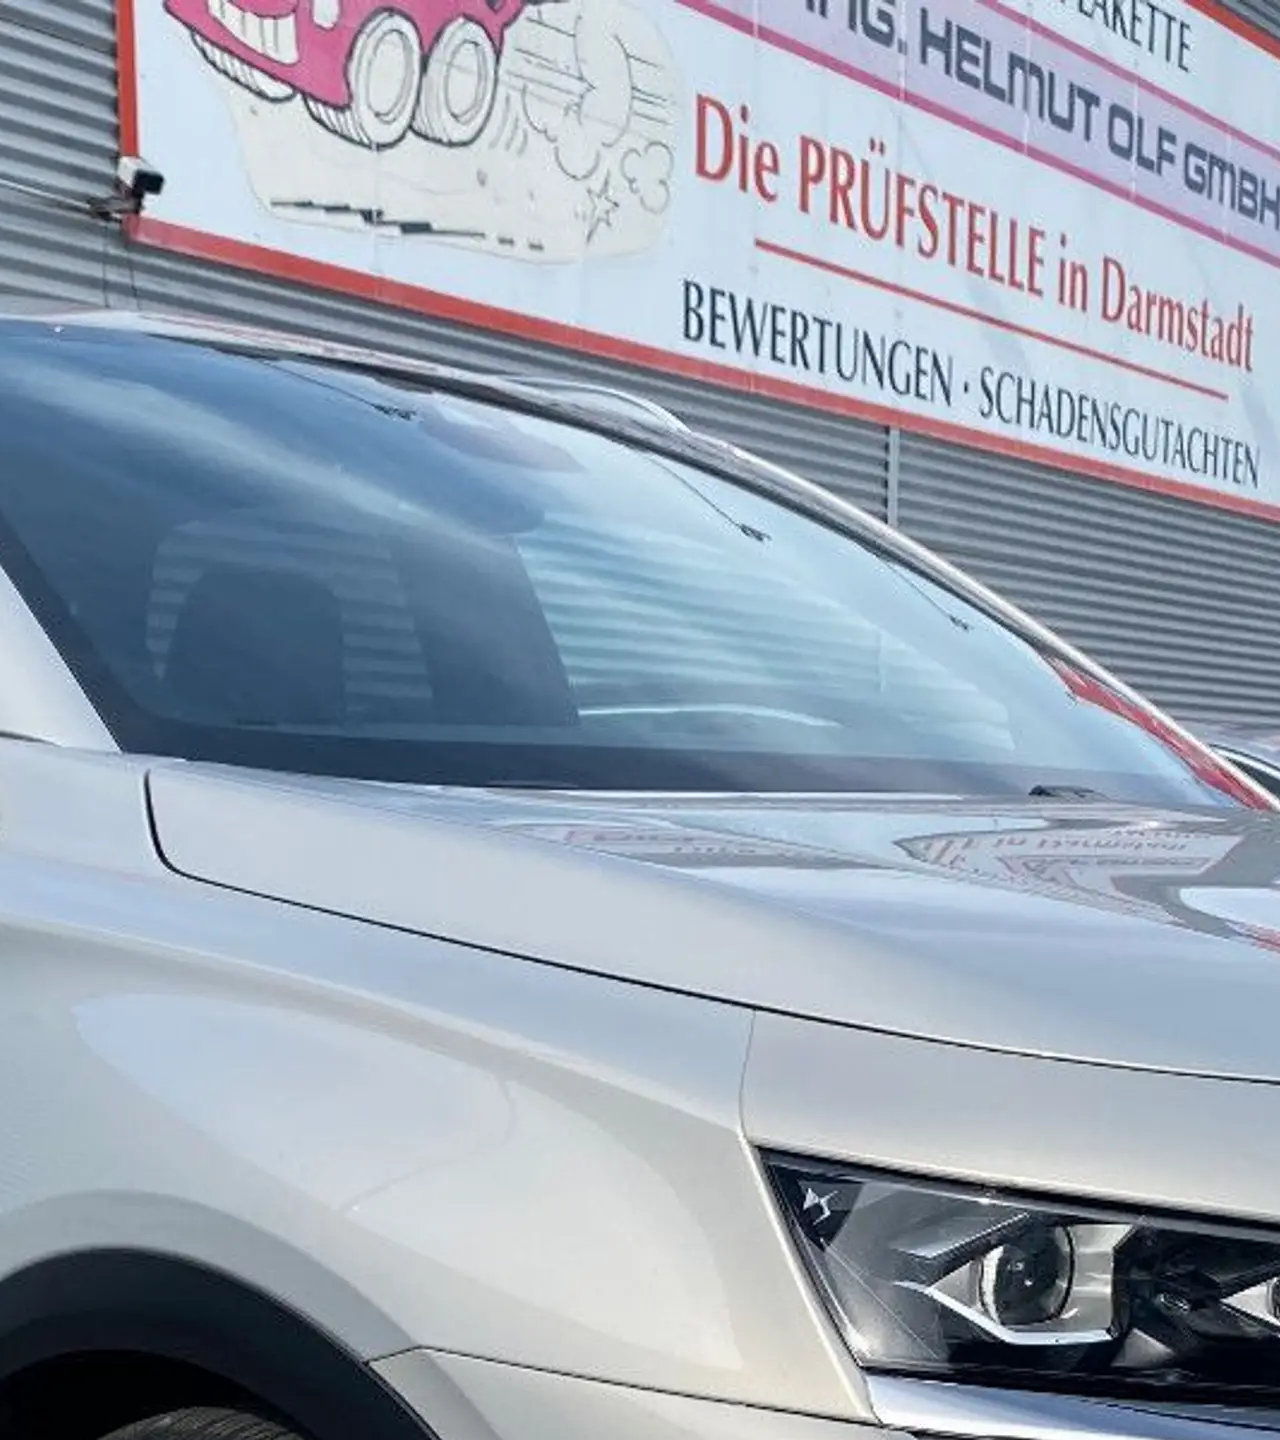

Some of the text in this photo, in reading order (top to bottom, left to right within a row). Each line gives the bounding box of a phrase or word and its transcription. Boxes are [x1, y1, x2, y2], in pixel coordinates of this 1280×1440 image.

[920, 4, 1100, 142] HELMUT
[1108, 102, 1177, 176] OLF
[1078, 0, 1192, 73] AKETTE
[695, 93, 1254, 372] Die PRÜFSTELLE in Darmstadt
[682, 280, 1260, 489] BEWERTUNGEN SCHADENSGUTACHTEN
